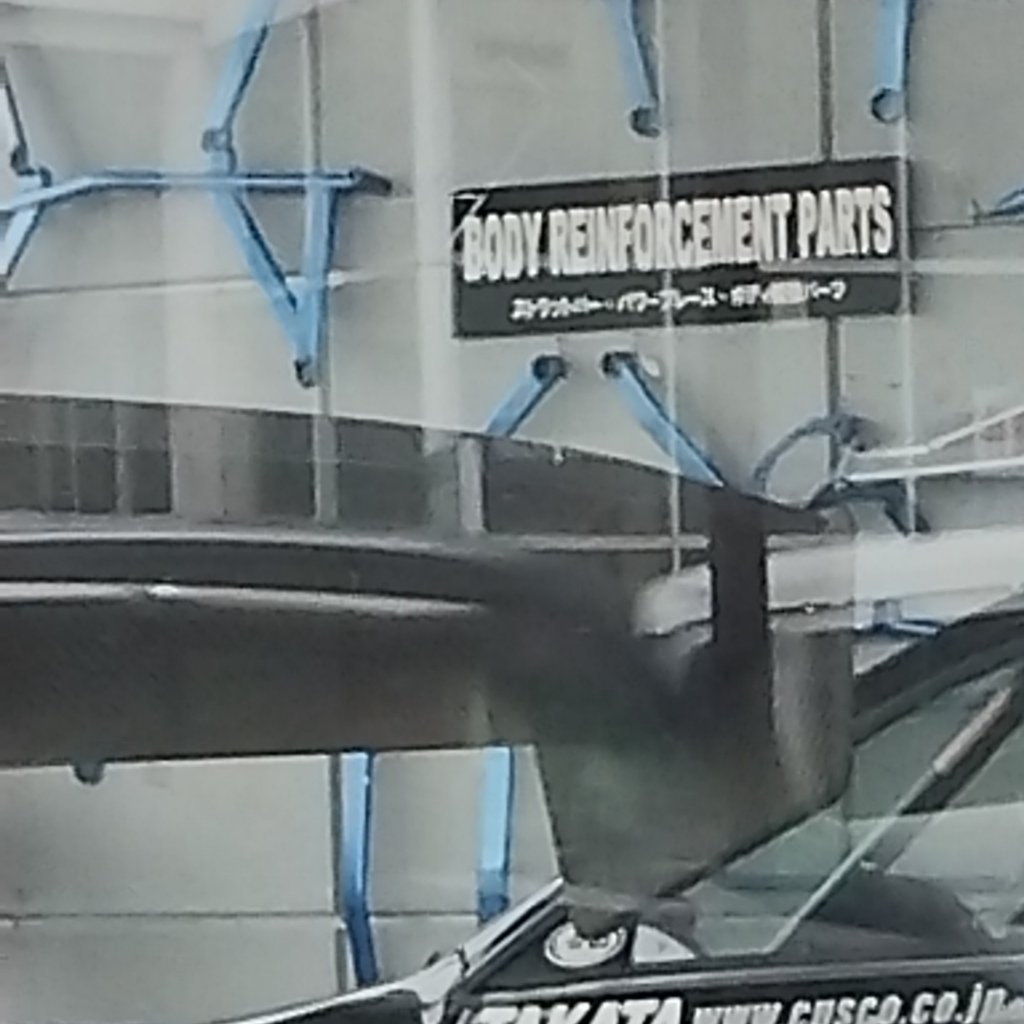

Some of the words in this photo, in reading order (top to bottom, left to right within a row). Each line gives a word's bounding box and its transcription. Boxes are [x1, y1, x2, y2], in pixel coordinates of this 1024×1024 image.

[463, 210, 542, 282] BODY
[547, 192, 791, 276] REINFORCEMENT
[797, 184, 893, 259] PARTS
